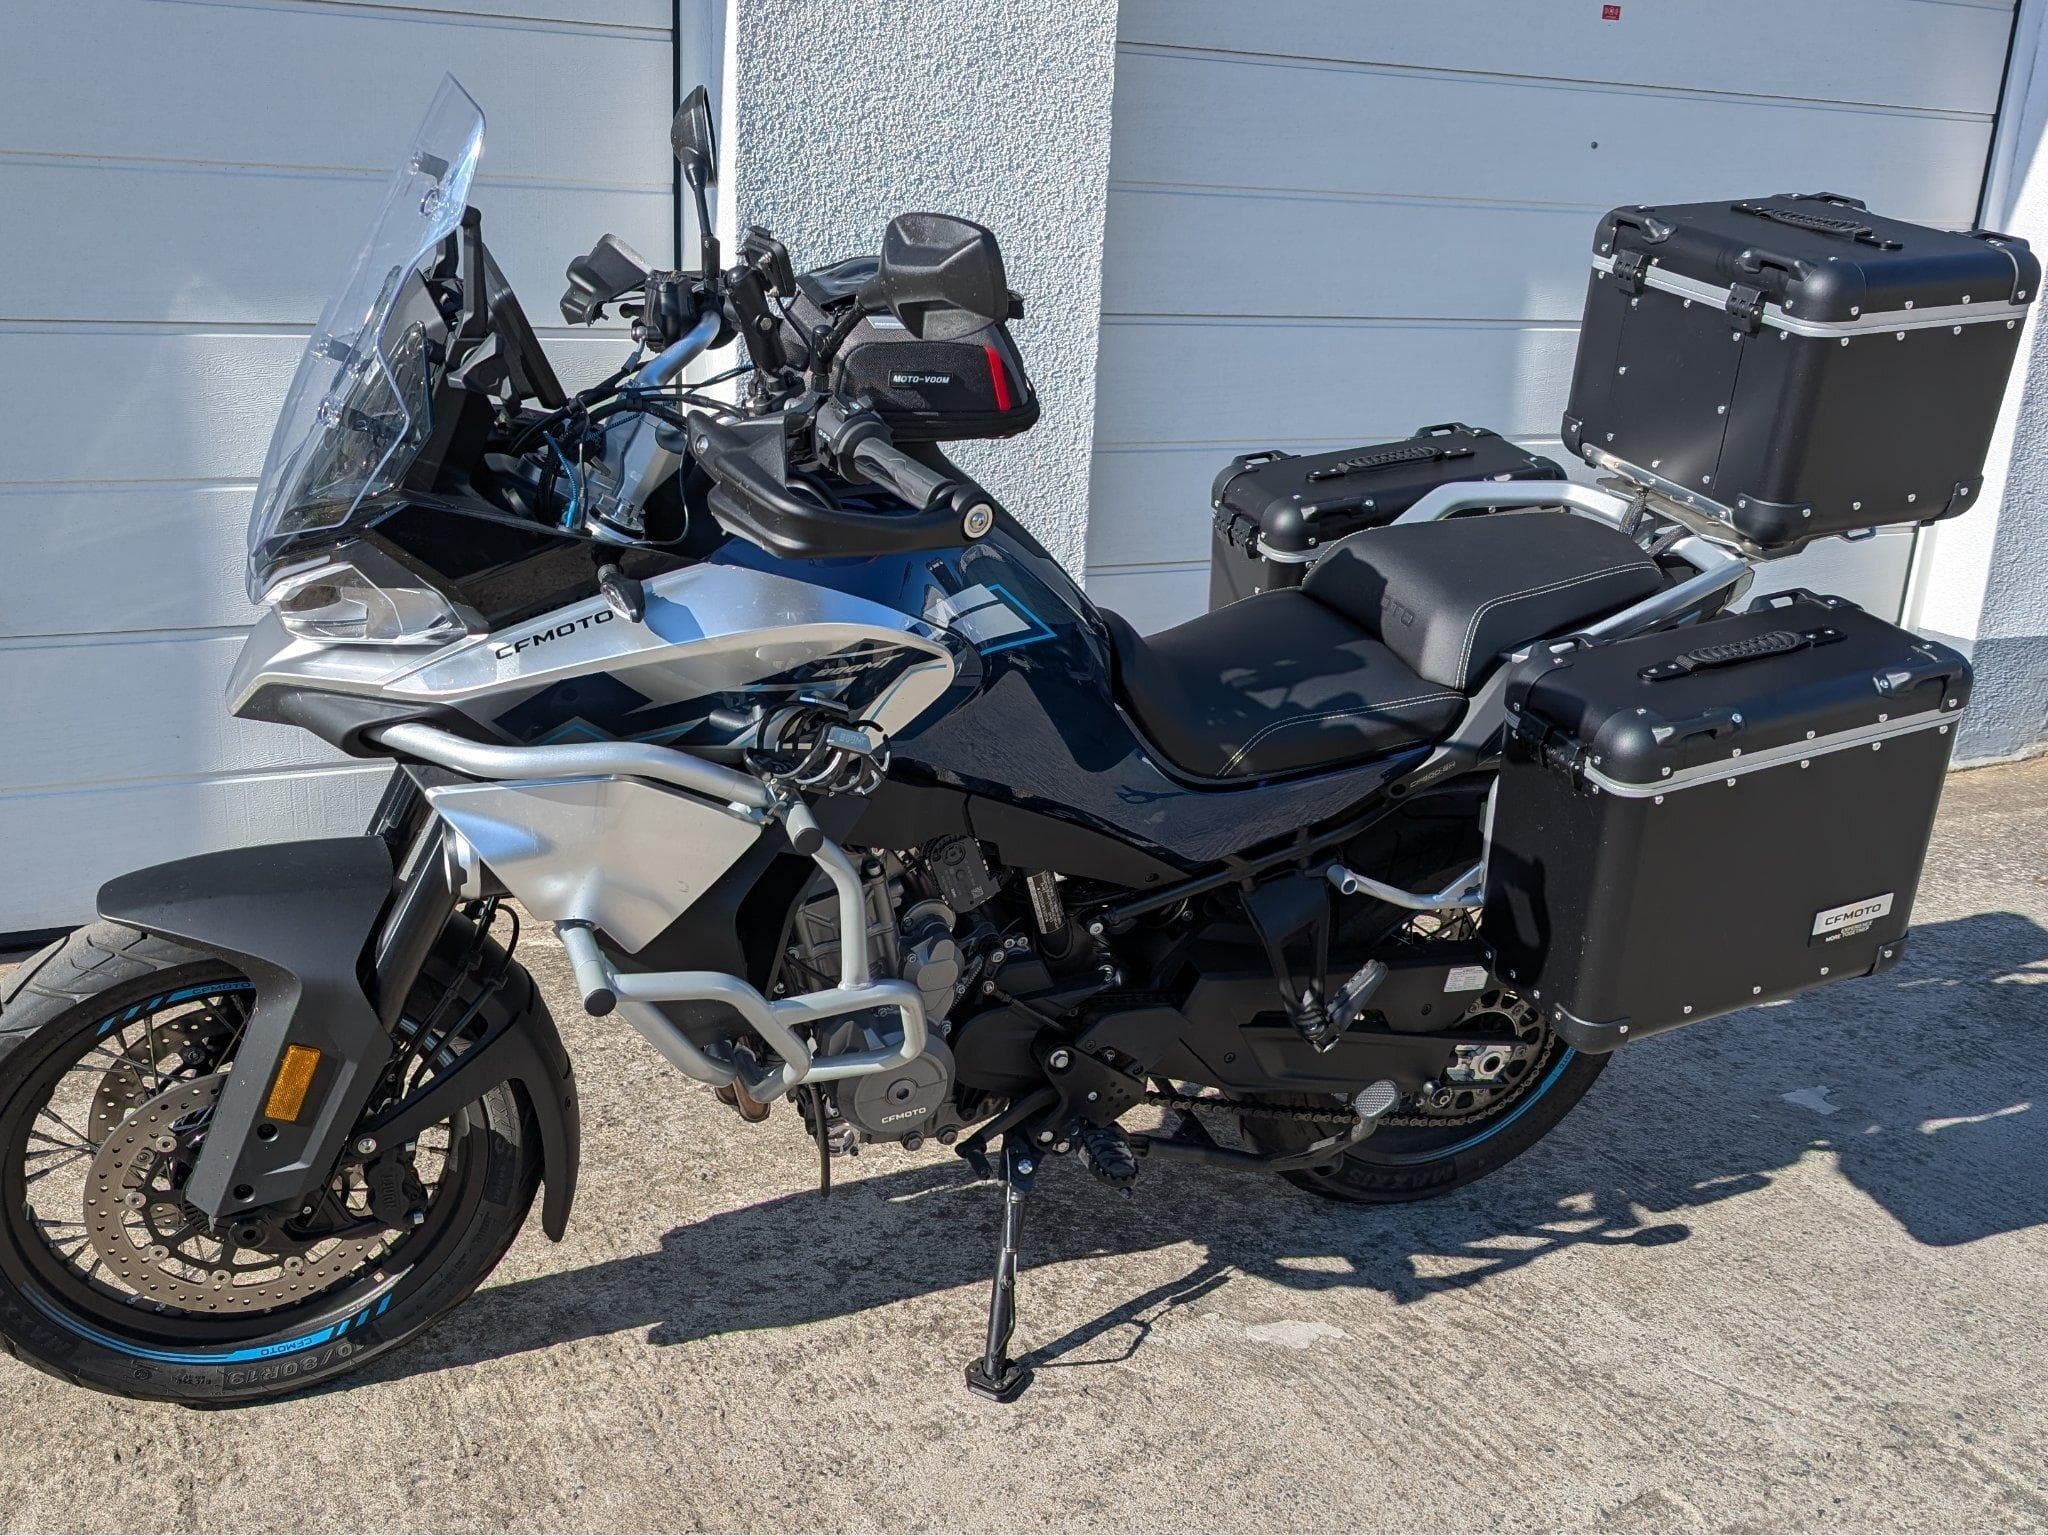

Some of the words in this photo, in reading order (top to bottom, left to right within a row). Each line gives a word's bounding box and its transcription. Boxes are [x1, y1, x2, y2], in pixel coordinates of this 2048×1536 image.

[892, 374, 951, 384] MOTO-VOOM
[495, 609, 615, 660] CFMOTO
[1825, 903, 1882, 926] CFMOTO
[191, 981, 251, 996] CFMOTO
[881, 1107, 927, 1124] CFMOTO
[259, 1335, 314, 1357] CFMOTO
